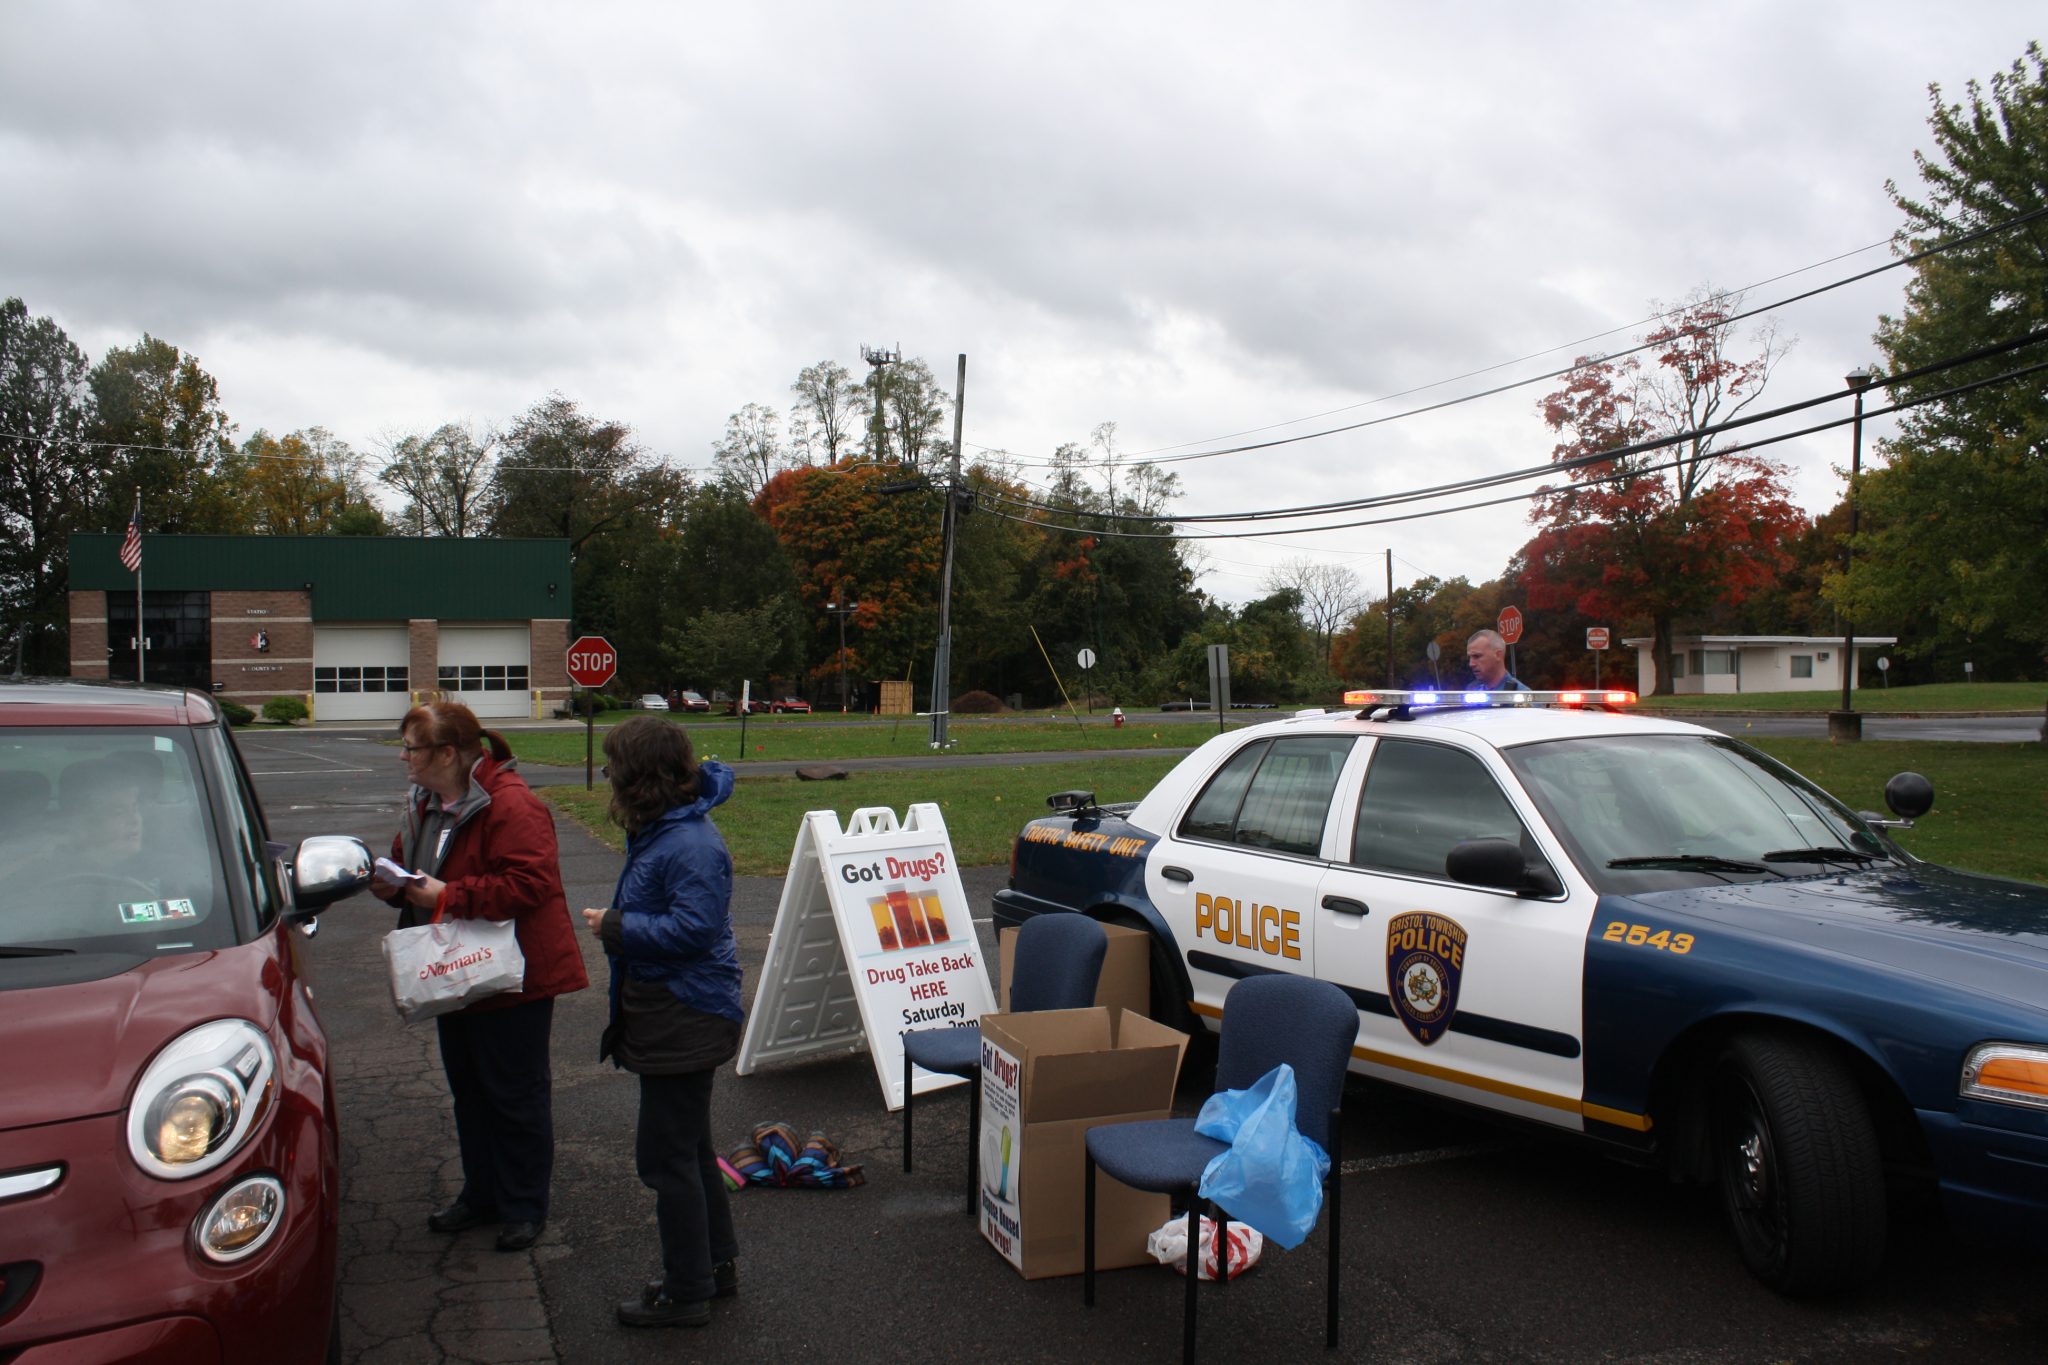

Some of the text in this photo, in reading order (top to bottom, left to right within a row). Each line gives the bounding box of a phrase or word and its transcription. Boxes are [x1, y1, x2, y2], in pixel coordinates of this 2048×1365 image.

[1500, 617, 1520, 634] STOP
[570, 652, 613, 671] STOP
[1025, 825, 1147, 858] TRAFFIC SAFETY UNIT
[841, 851, 945, 884] Got Drugs?
[1195, 891, 1302, 962] POLICE
[1390, 915, 1466, 945] BRISTOL TOWNSHIP
[1602, 921, 1695, 955] 2543
[420, 947, 493, 980] Norman's
[1389, 928, 1463, 971] POLICE
[867, 953, 974, 985] Drug Take Back
[910, 980, 949, 1001] HERE
[902, 1000, 965, 1025] Saturday
[1420, 1027, 1430, 1040] PA
[982, 1041, 993, 1073] Got
[994, 1050, 1018, 1090] Drugs?
